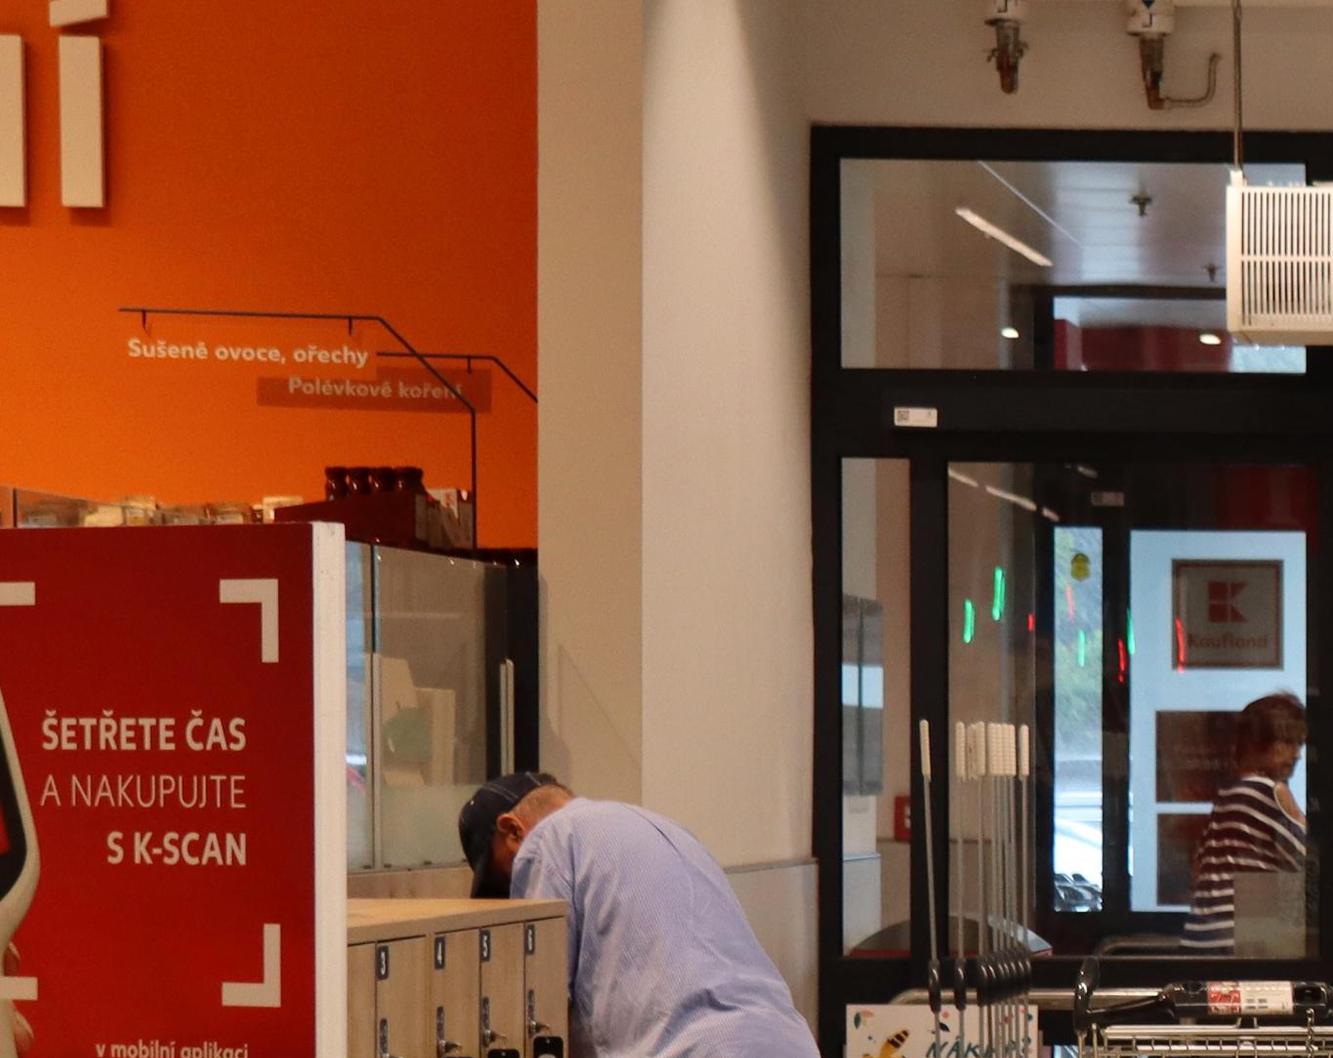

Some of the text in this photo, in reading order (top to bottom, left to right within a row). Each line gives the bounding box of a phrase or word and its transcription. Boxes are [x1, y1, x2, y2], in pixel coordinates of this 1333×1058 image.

[127, 337, 368, 369] Sušené ovoce, ořechy
[288, 376, 393, 398] Polévkové
[42, 709, 247, 751] ŠETŘETE ČAS
[40, 774, 246, 808] A NAKUPUJTE
[107, 831, 247, 866] S K-SCAN
[95, 1043, 106, 1058] v
